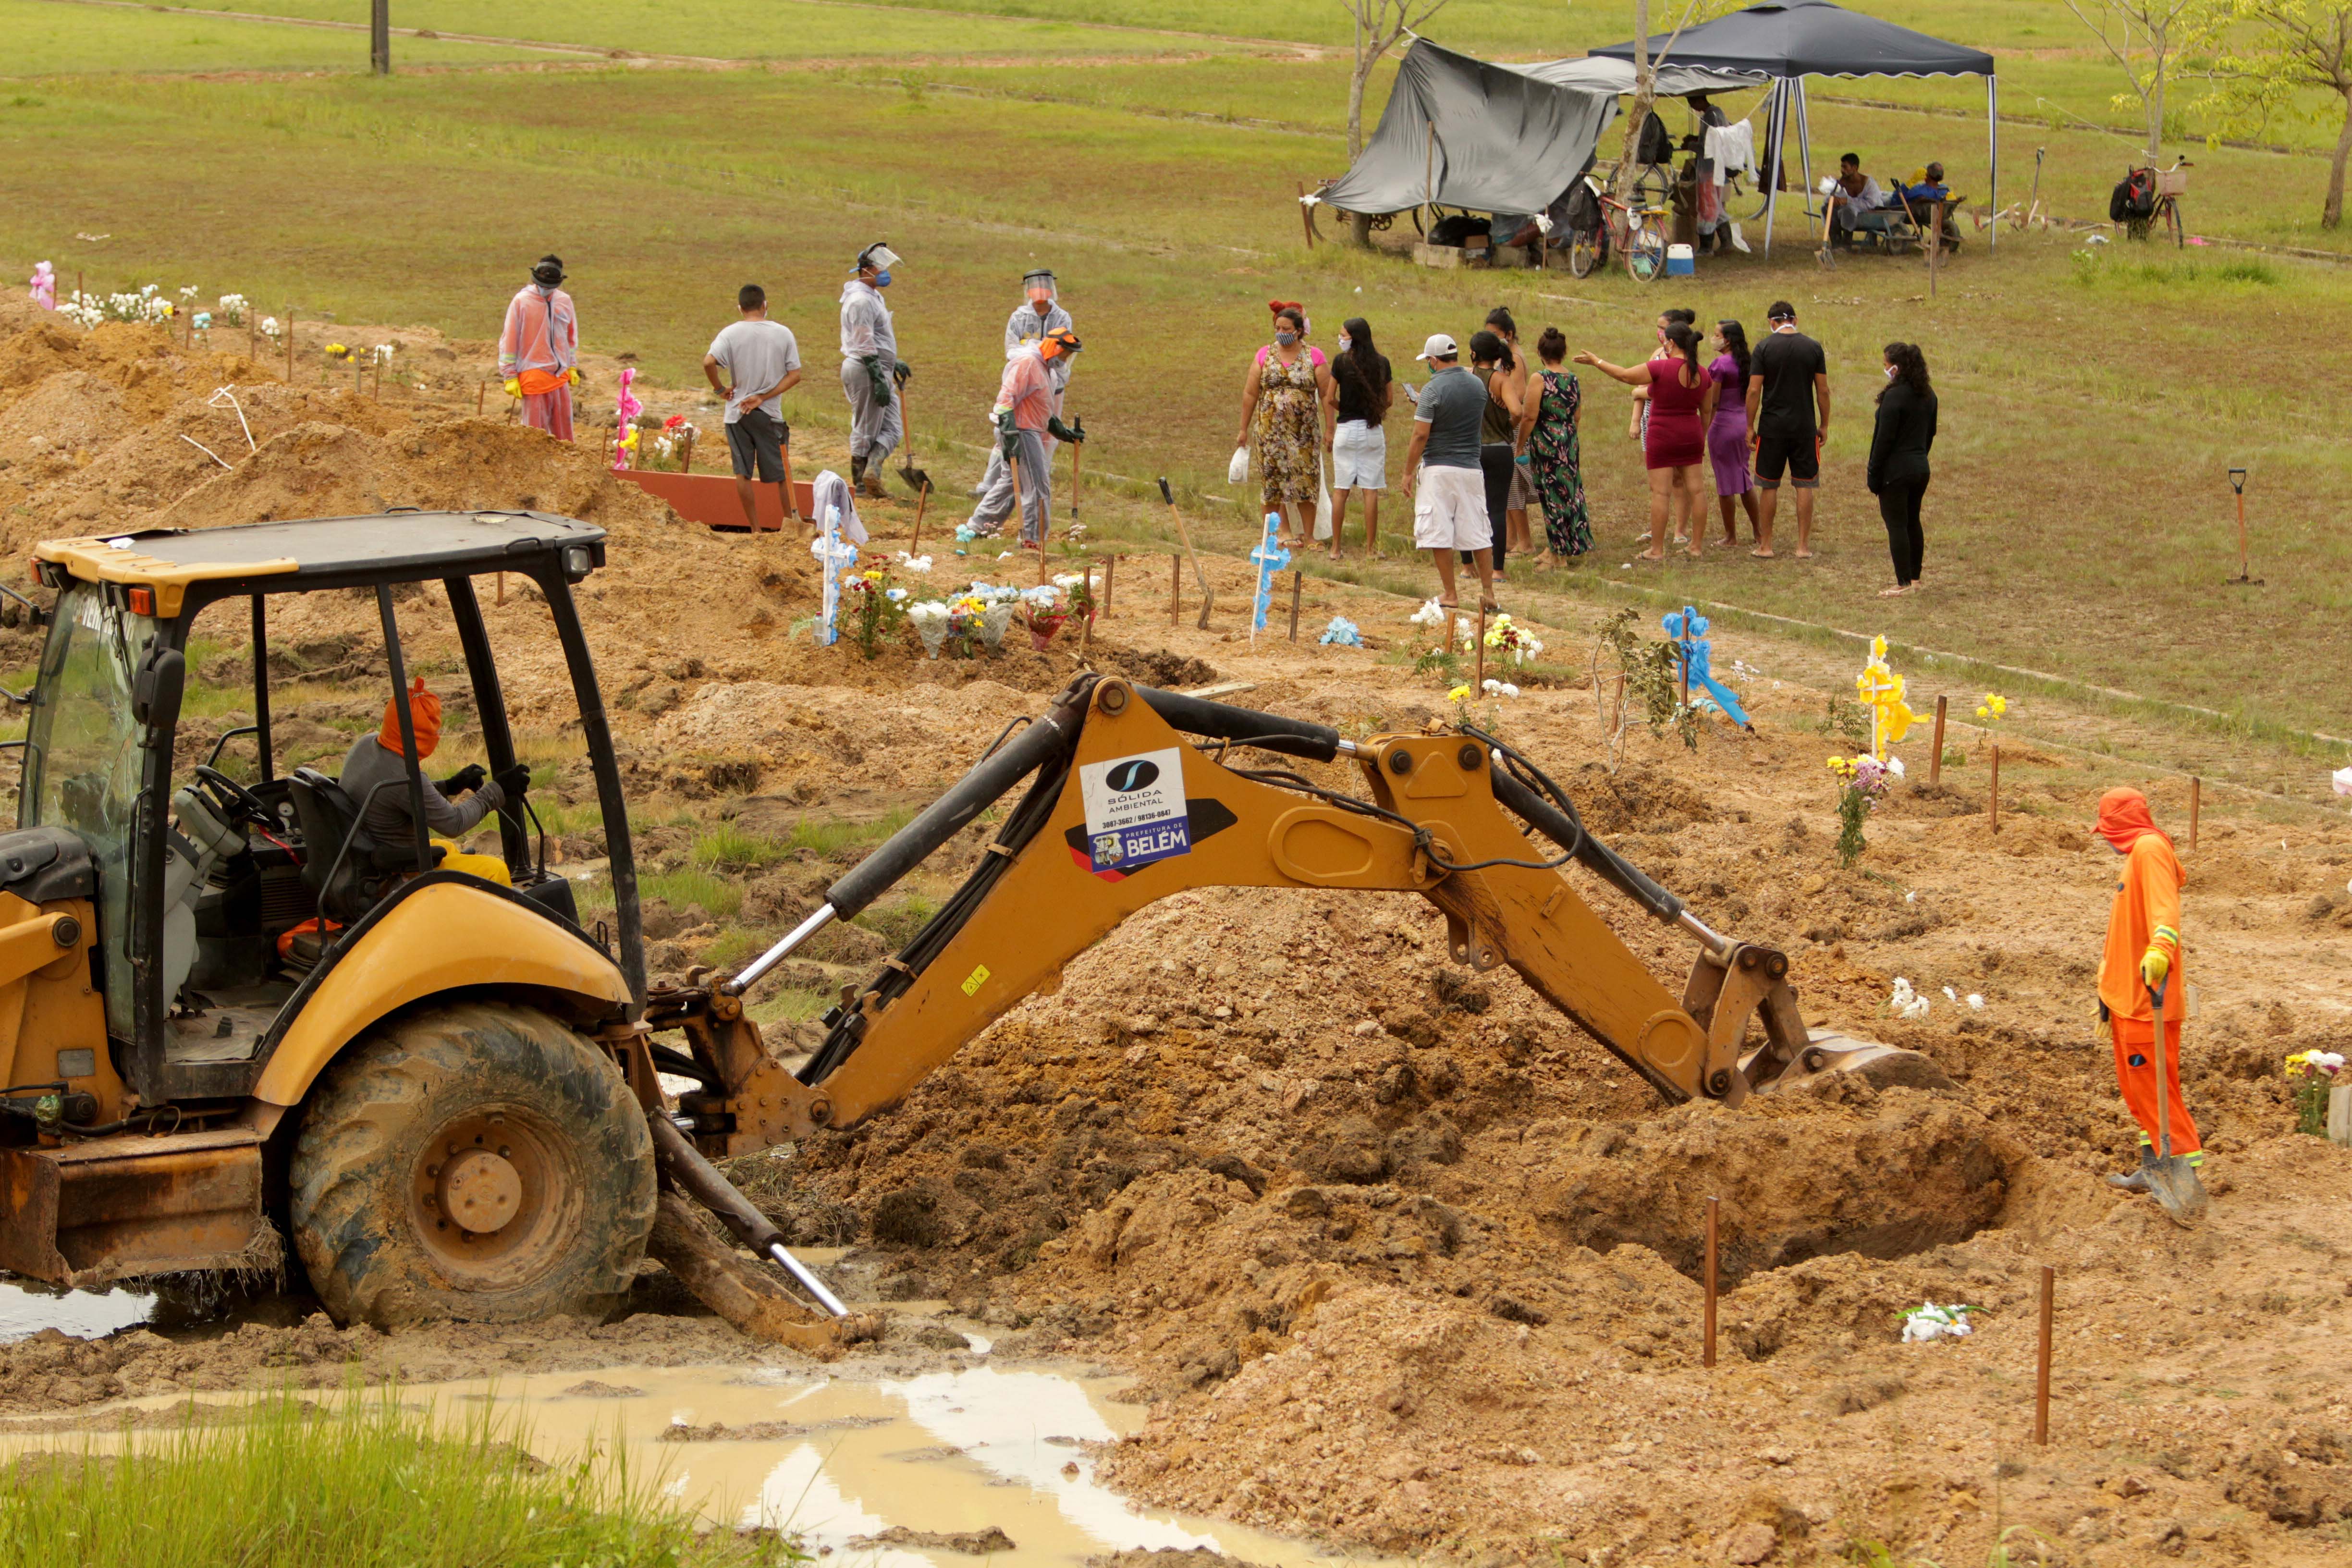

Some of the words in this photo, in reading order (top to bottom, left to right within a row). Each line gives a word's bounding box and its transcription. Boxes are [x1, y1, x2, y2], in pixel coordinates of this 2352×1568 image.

[1108, 790, 1162, 805] SÓLIDA
[1109, 798, 1163, 814] AMBIENTAL
[1102, 817, 1133, 829] 3087-3662
[1138, 809, 1171, 821] 98136-0847
[1126, 825, 1171, 838] PREFEITURA
[1127, 829, 1187, 858] BELÉM
